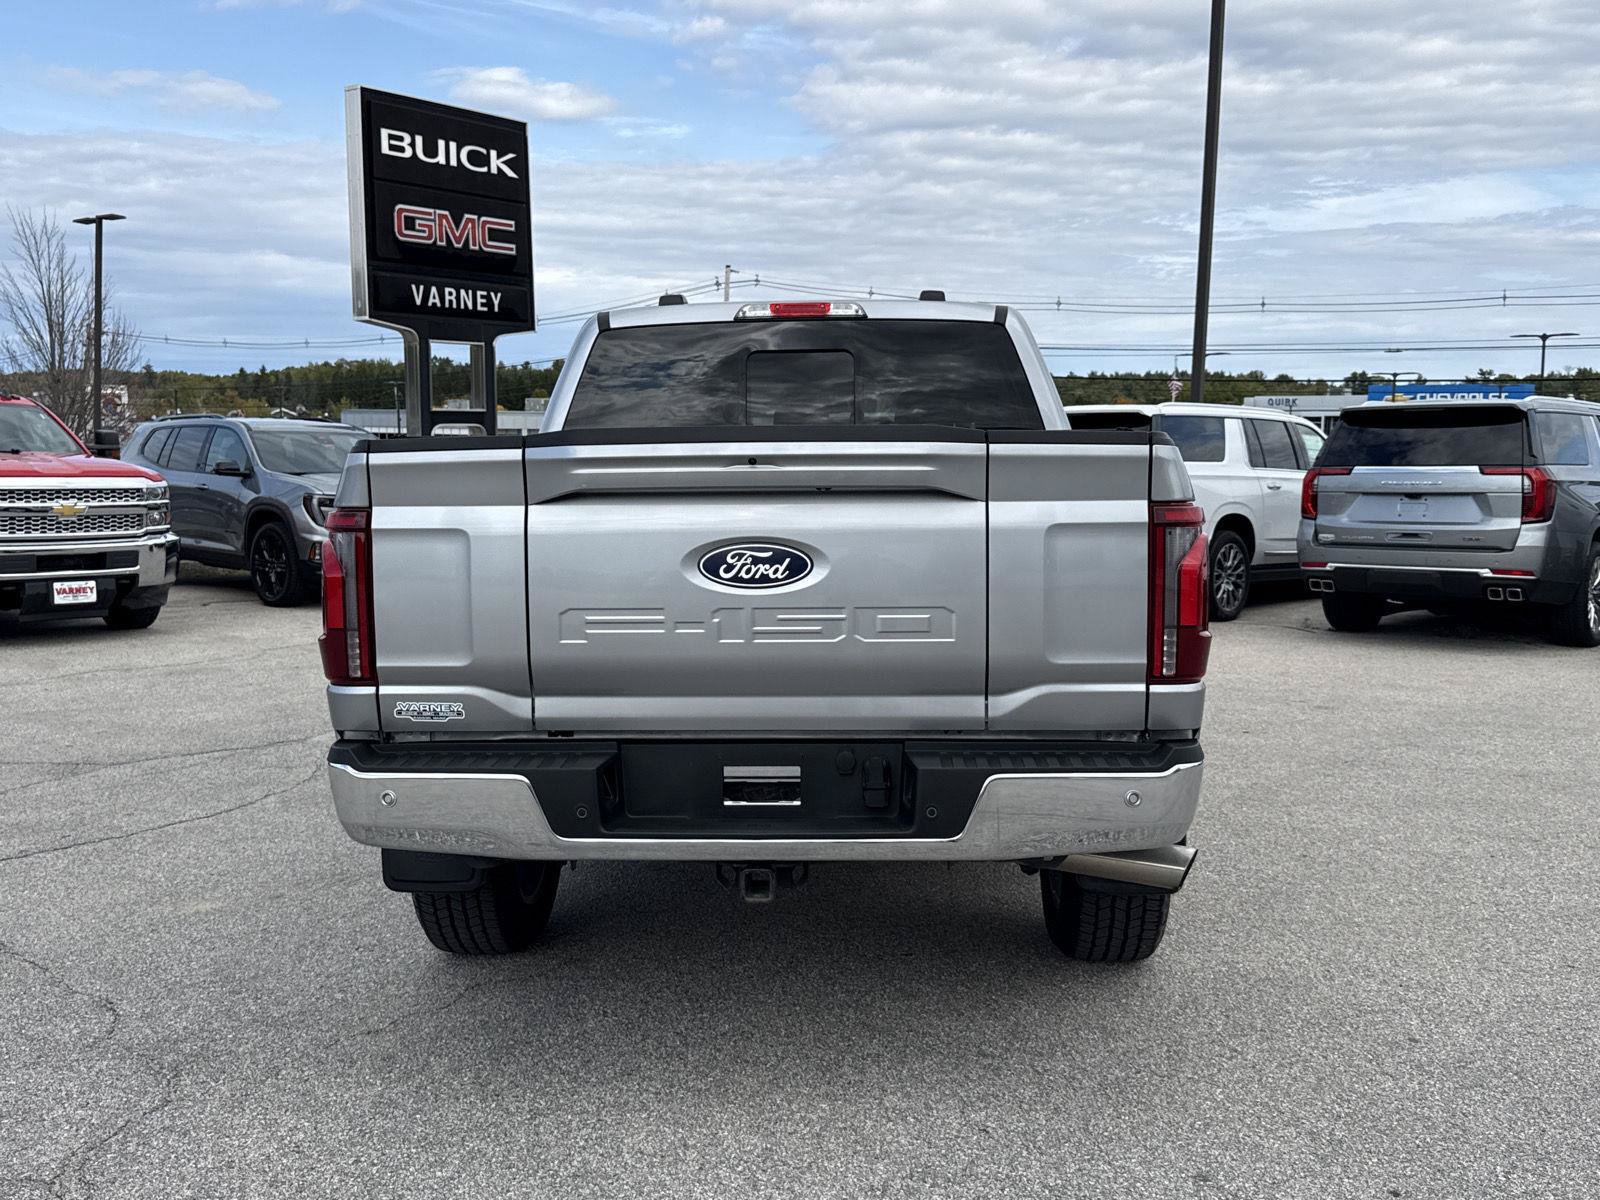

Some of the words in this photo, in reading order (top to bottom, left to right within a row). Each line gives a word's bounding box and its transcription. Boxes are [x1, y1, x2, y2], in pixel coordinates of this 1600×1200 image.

[380, 128, 519, 179] BUICK
[394, 204, 517, 255] GMC
[411, 284, 502, 313] VARNEY
[1267, 397, 1298, 407] QUIRK
[718, 549, 789, 580] Ford
[55, 586, 94, 595] VARNEY
[559, 606, 957, 644] F-150
[399, 703, 462, 712] VARNEY
